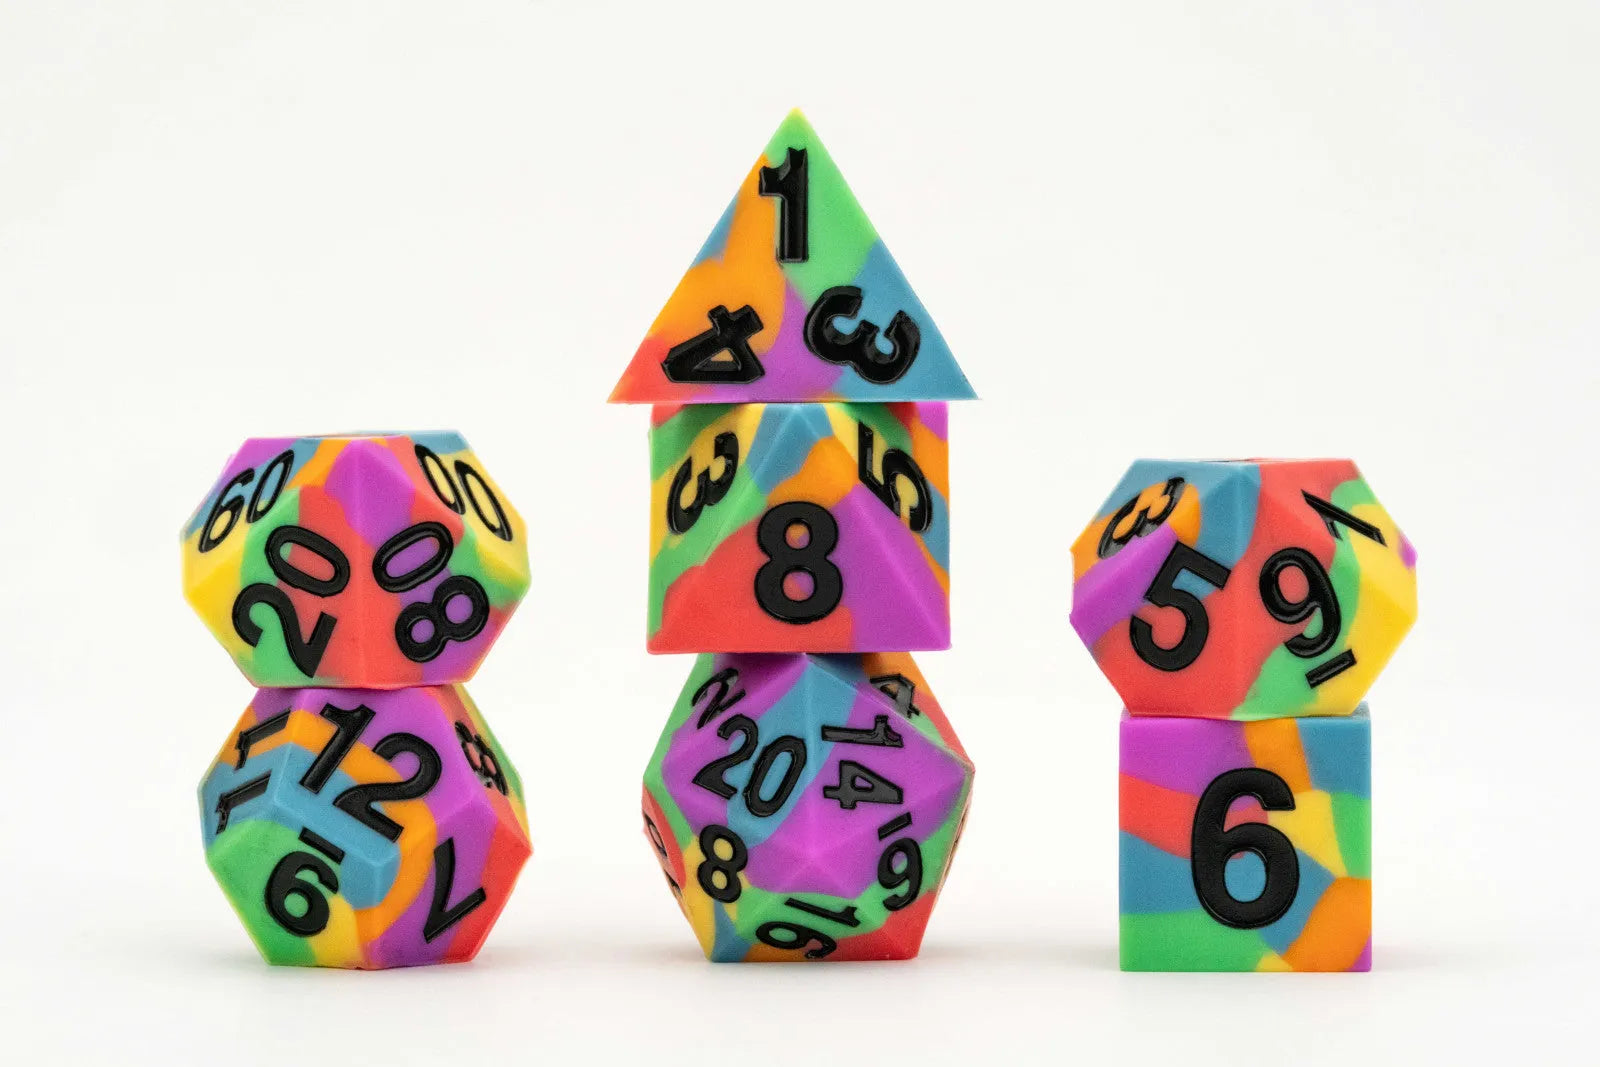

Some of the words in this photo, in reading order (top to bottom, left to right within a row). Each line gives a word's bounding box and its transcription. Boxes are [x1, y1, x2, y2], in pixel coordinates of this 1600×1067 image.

[758, 146, 810, 263] 1
[661, 304, 766, 384] 4
[803, 285, 921, 385] 3
[198, 449, 295, 553] 60
[414, 444, 513, 541] 00
[667, 431, 740, 535] 3
[857, 420, 933, 533] 5
[1097, 477, 1185, 559] 3
[231, 524, 351, 679] 20
[372, 521, 491, 663] 80
[754, 501, 844, 625] 8
[1129, 540, 1232, 672] 5
[1259, 547, 1357, 689] 9
[298, 702, 443, 843] 12
[691, 713, 808, 818] 20
[820, 714, 905, 811] 14
[422, 837, 487, 944] 7
[696, 824, 749, 904] 8
[1190, 767, 1300, 930] 6
[754, 897, 861, 960] 16
